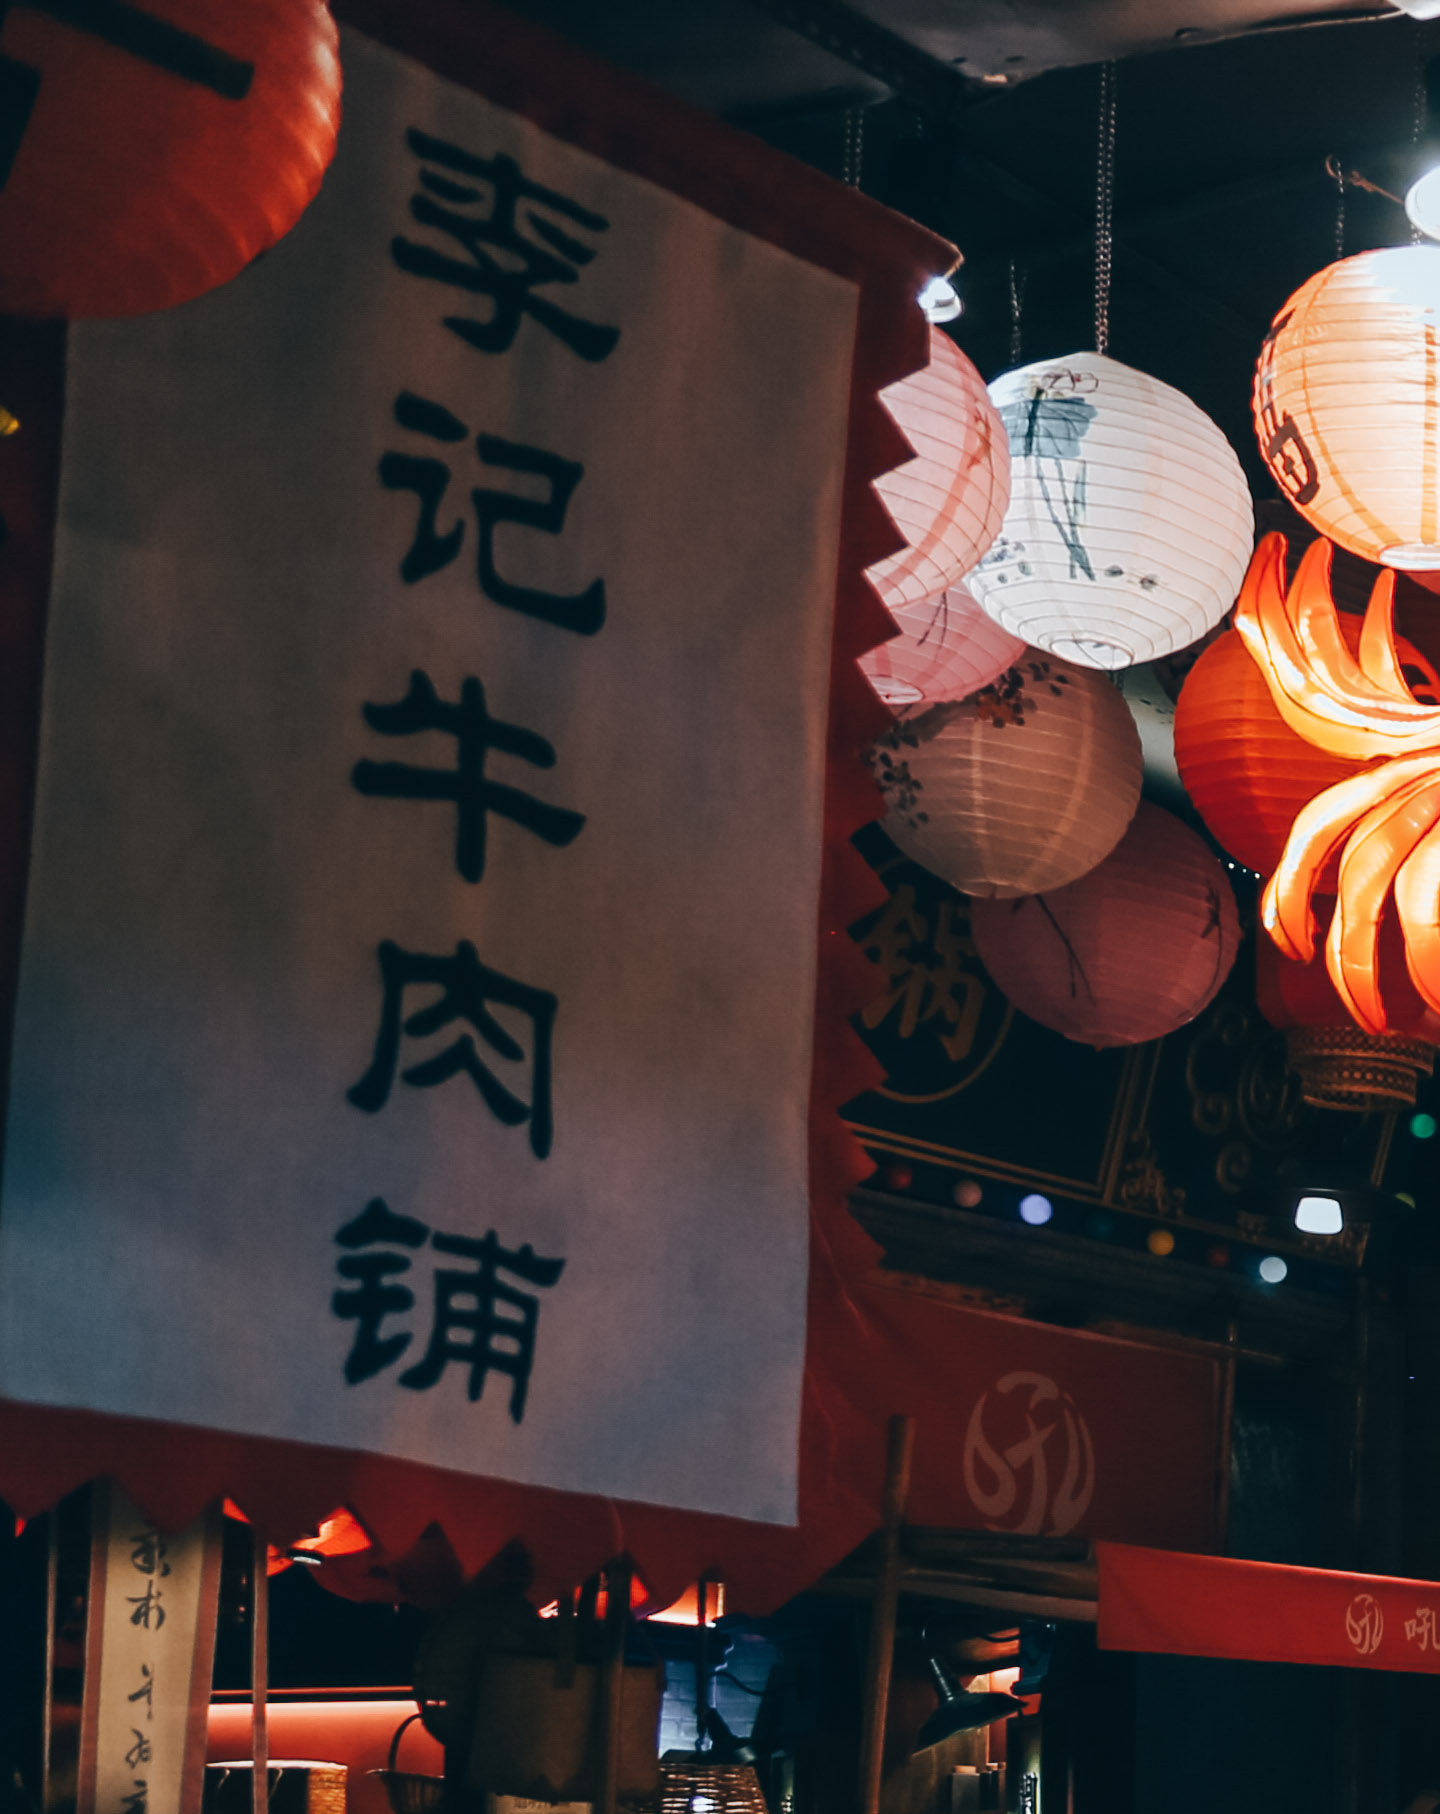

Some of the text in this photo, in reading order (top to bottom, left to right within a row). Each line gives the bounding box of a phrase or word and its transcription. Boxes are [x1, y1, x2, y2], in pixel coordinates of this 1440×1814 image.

[328, 124, 623, 1426] 李记牛肉铺
